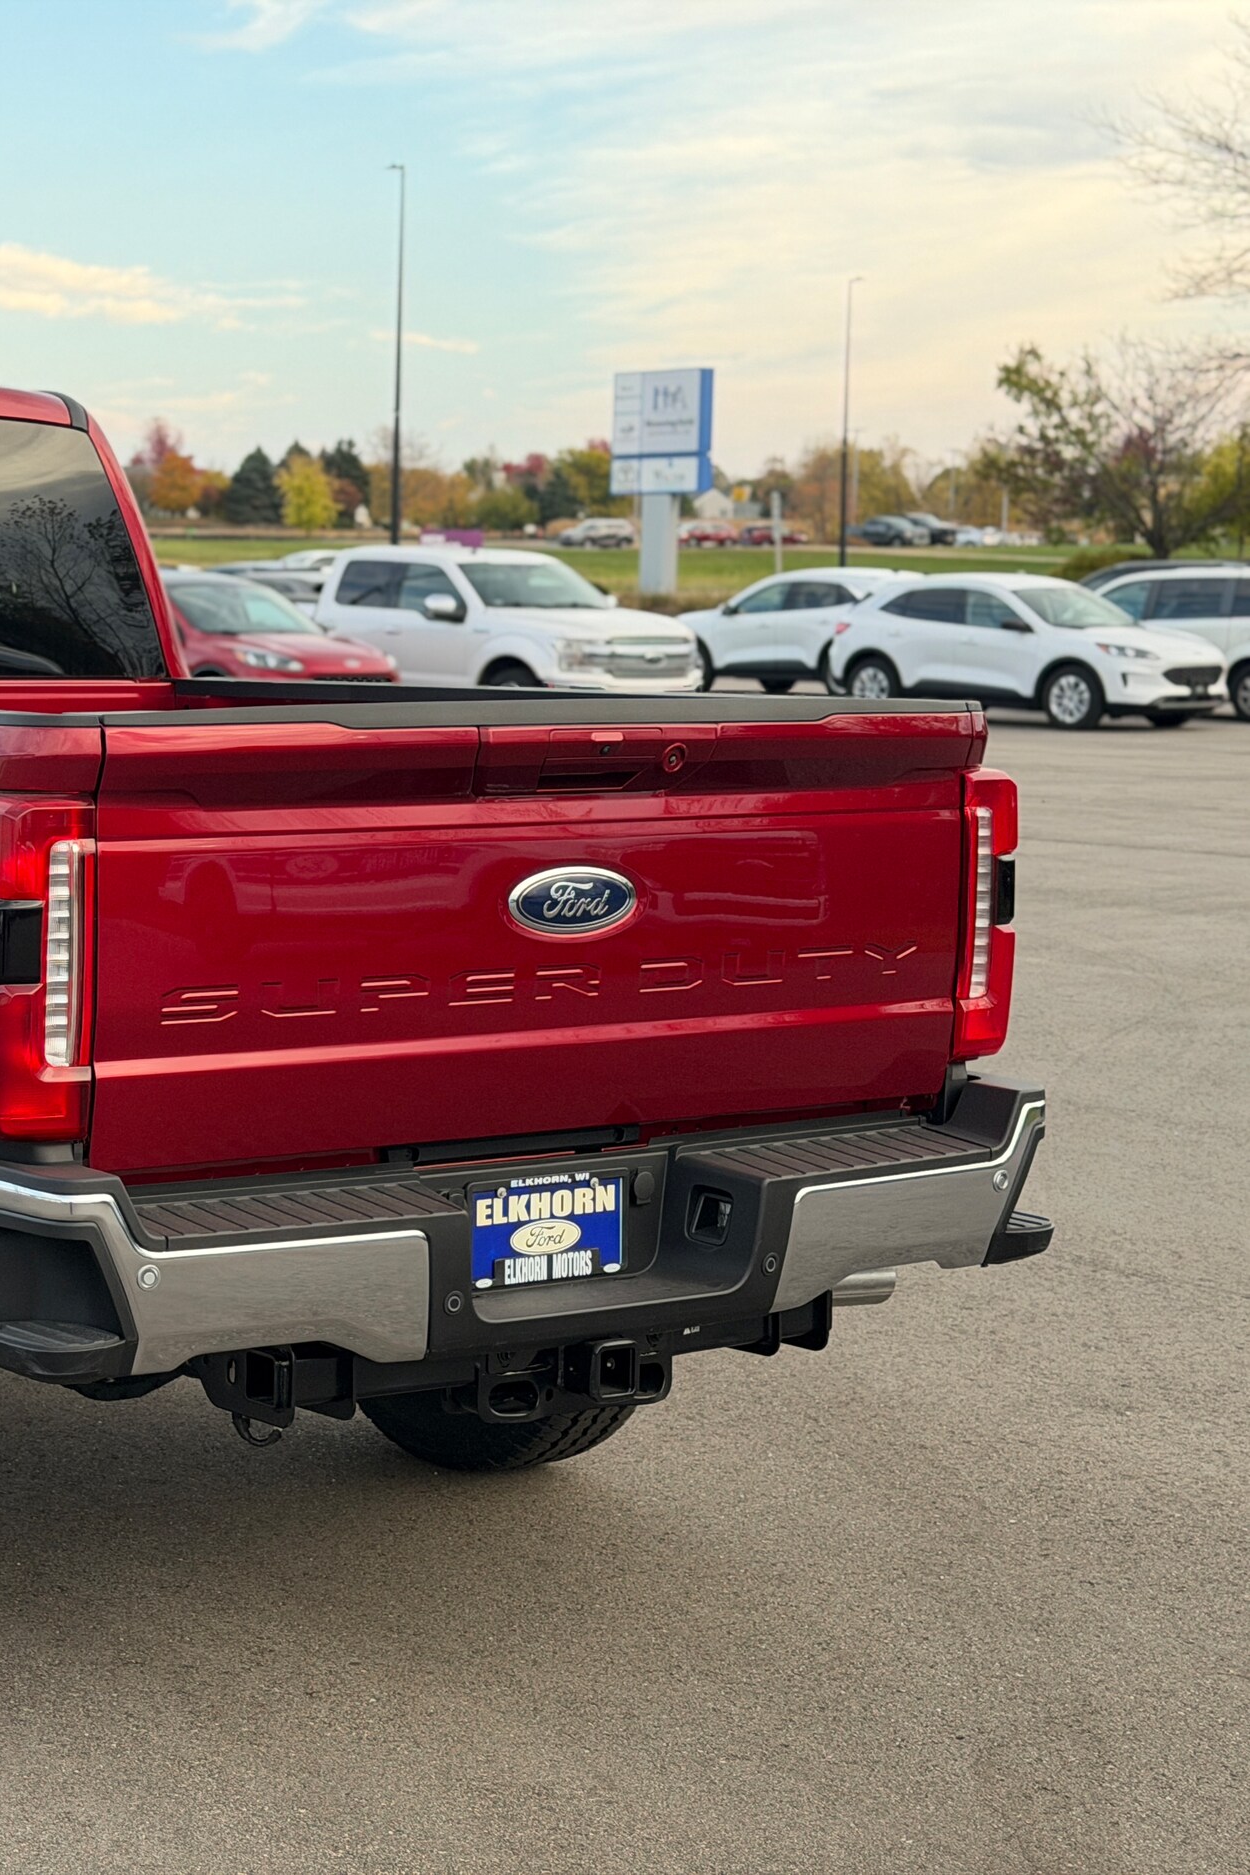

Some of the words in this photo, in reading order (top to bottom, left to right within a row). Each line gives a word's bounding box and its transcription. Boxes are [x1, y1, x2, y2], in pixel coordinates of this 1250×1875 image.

[543, 881, 611, 918] Ford
[160, 964, 598, 1025] SUPER
[639, 939, 919, 993] DUTY
[510, 1175, 571, 1188] ELKHORN,
[575, 1172, 590, 1181] WI
[476, 1184, 616, 1227] ELKHORN
[525, 1225, 566, 1248] Ford
[504, 1255, 548, 1285] ELKHORN
[552, 1250, 592, 1280] MOTORS
